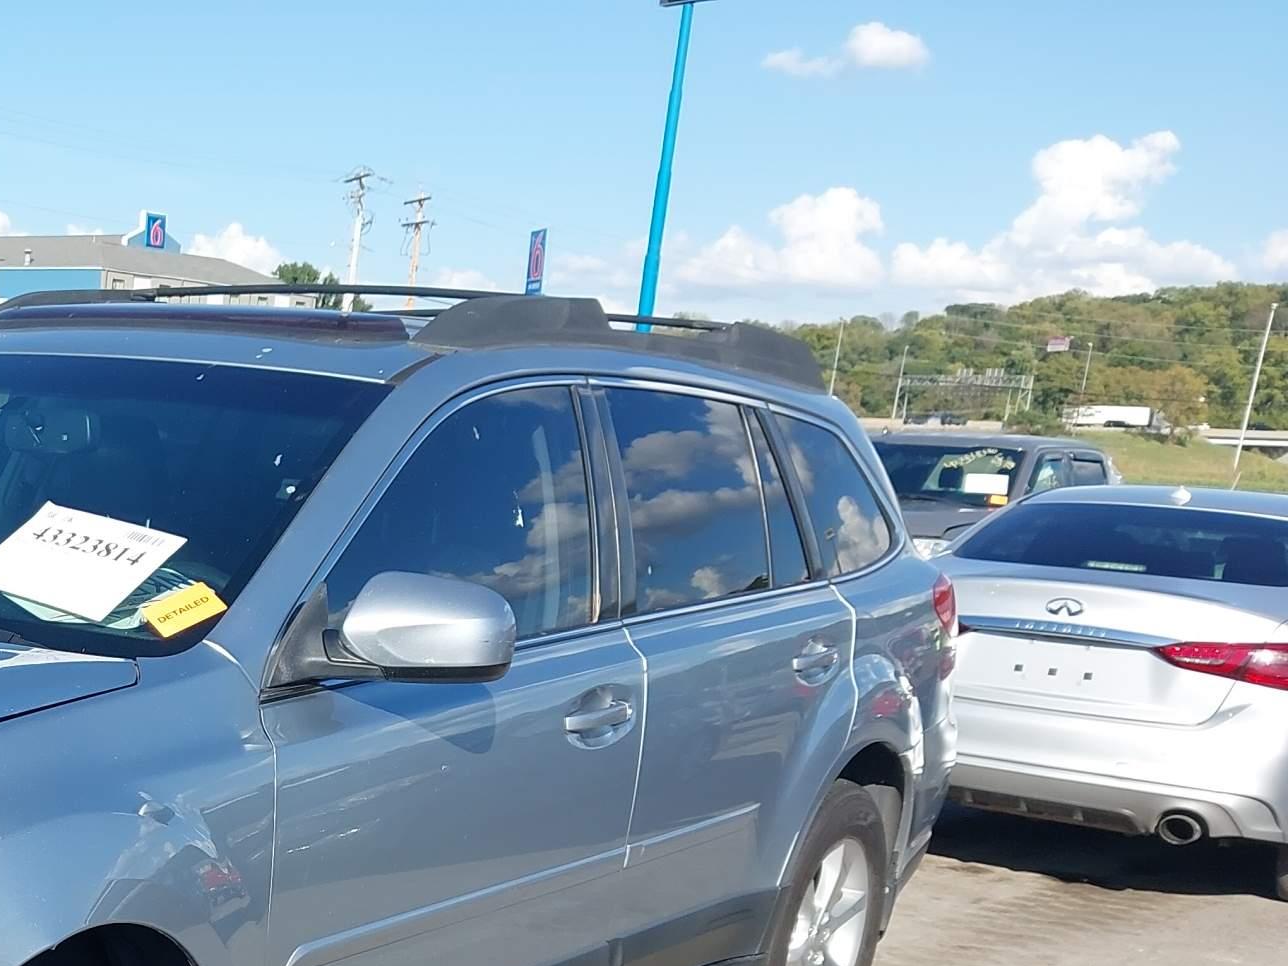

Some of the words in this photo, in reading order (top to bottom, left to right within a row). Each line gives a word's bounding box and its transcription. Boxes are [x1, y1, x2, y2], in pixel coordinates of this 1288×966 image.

[150, 218, 164, 246] 6
[530, 230, 545, 279] 6
[31, 526, 147, 566] 43323814
[157, 595, 210, 624] DETAILED
